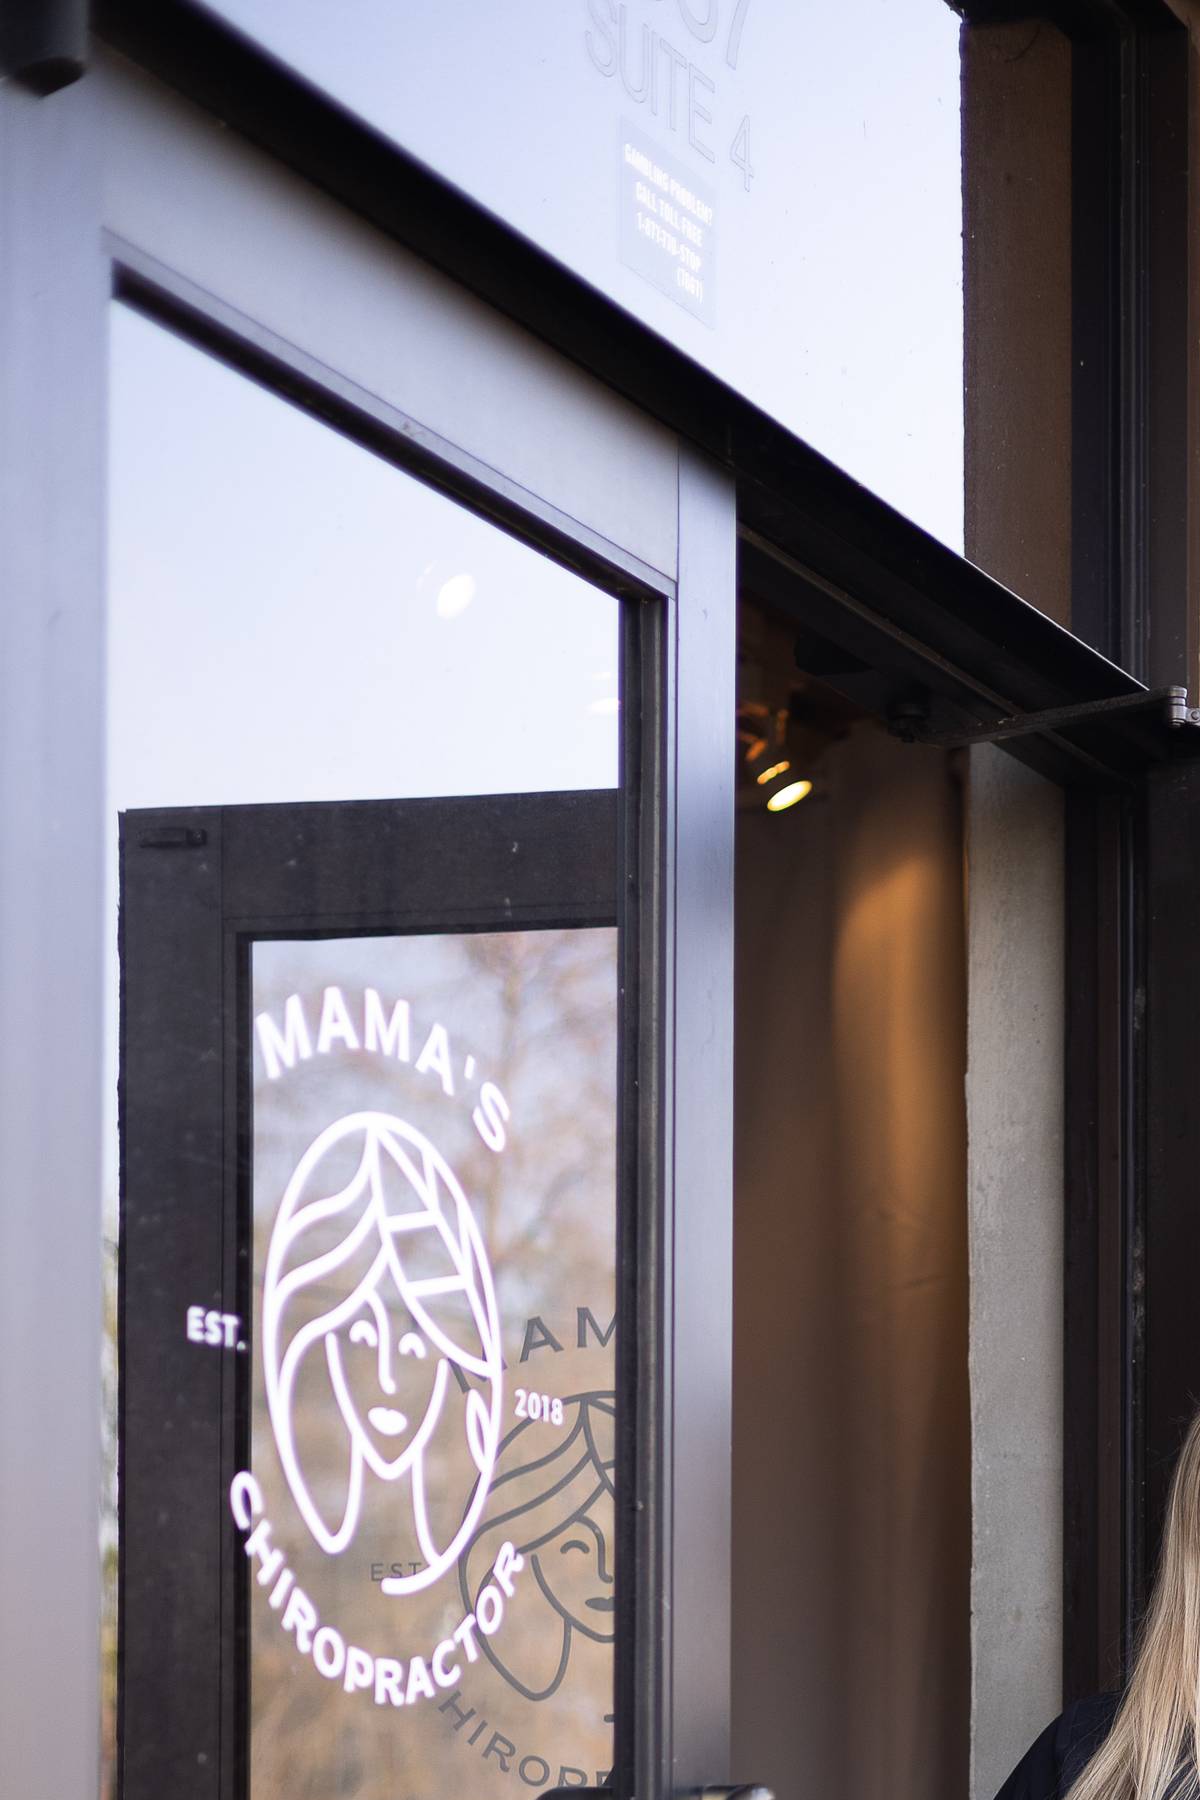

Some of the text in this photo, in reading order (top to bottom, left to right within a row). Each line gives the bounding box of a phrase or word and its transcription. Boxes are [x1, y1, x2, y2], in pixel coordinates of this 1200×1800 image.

[584, 0, 715, 164] SUITE
[729, 114, 755, 193] 4
[636, 181, 703, 248] CALL TOLL FREE
[669, 178, 713, 227] PROBLEM?
[253, 986, 511, 1153] MAMA'S
[187, 1305, 247, 1351] EST.
[514, 1388, 563, 1425] 2018
[230, 1470, 525, 1706] CHIROPRACTOR
